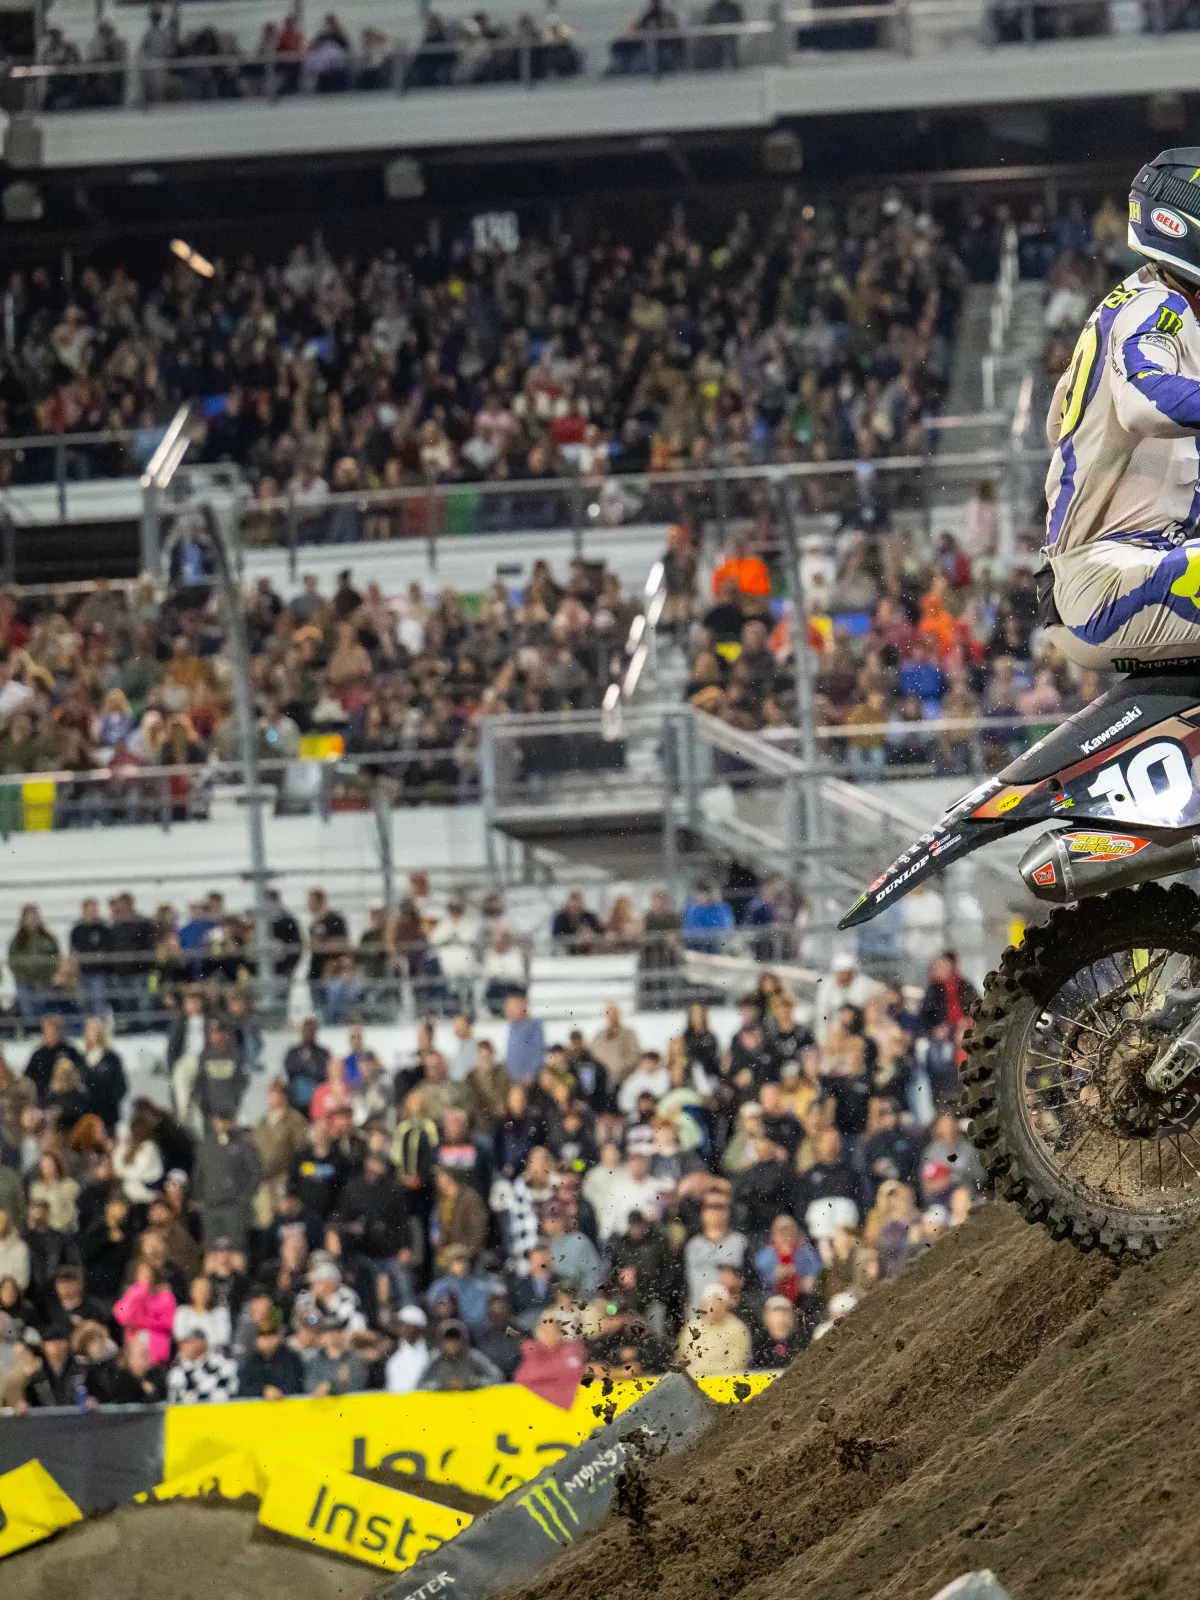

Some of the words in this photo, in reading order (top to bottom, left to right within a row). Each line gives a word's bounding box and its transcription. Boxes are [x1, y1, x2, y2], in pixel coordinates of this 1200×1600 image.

[1155, 212, 1181, 234] BELL
[1080, 705, 1143, 755] Kawasaki
[1087, 741, 1194, 828] 10
[1069, 842, 1133, 854] CIRCUIT
[1075, 835, 1112, 845] PRO
[875, 854, 930, 904] DUNLOP
